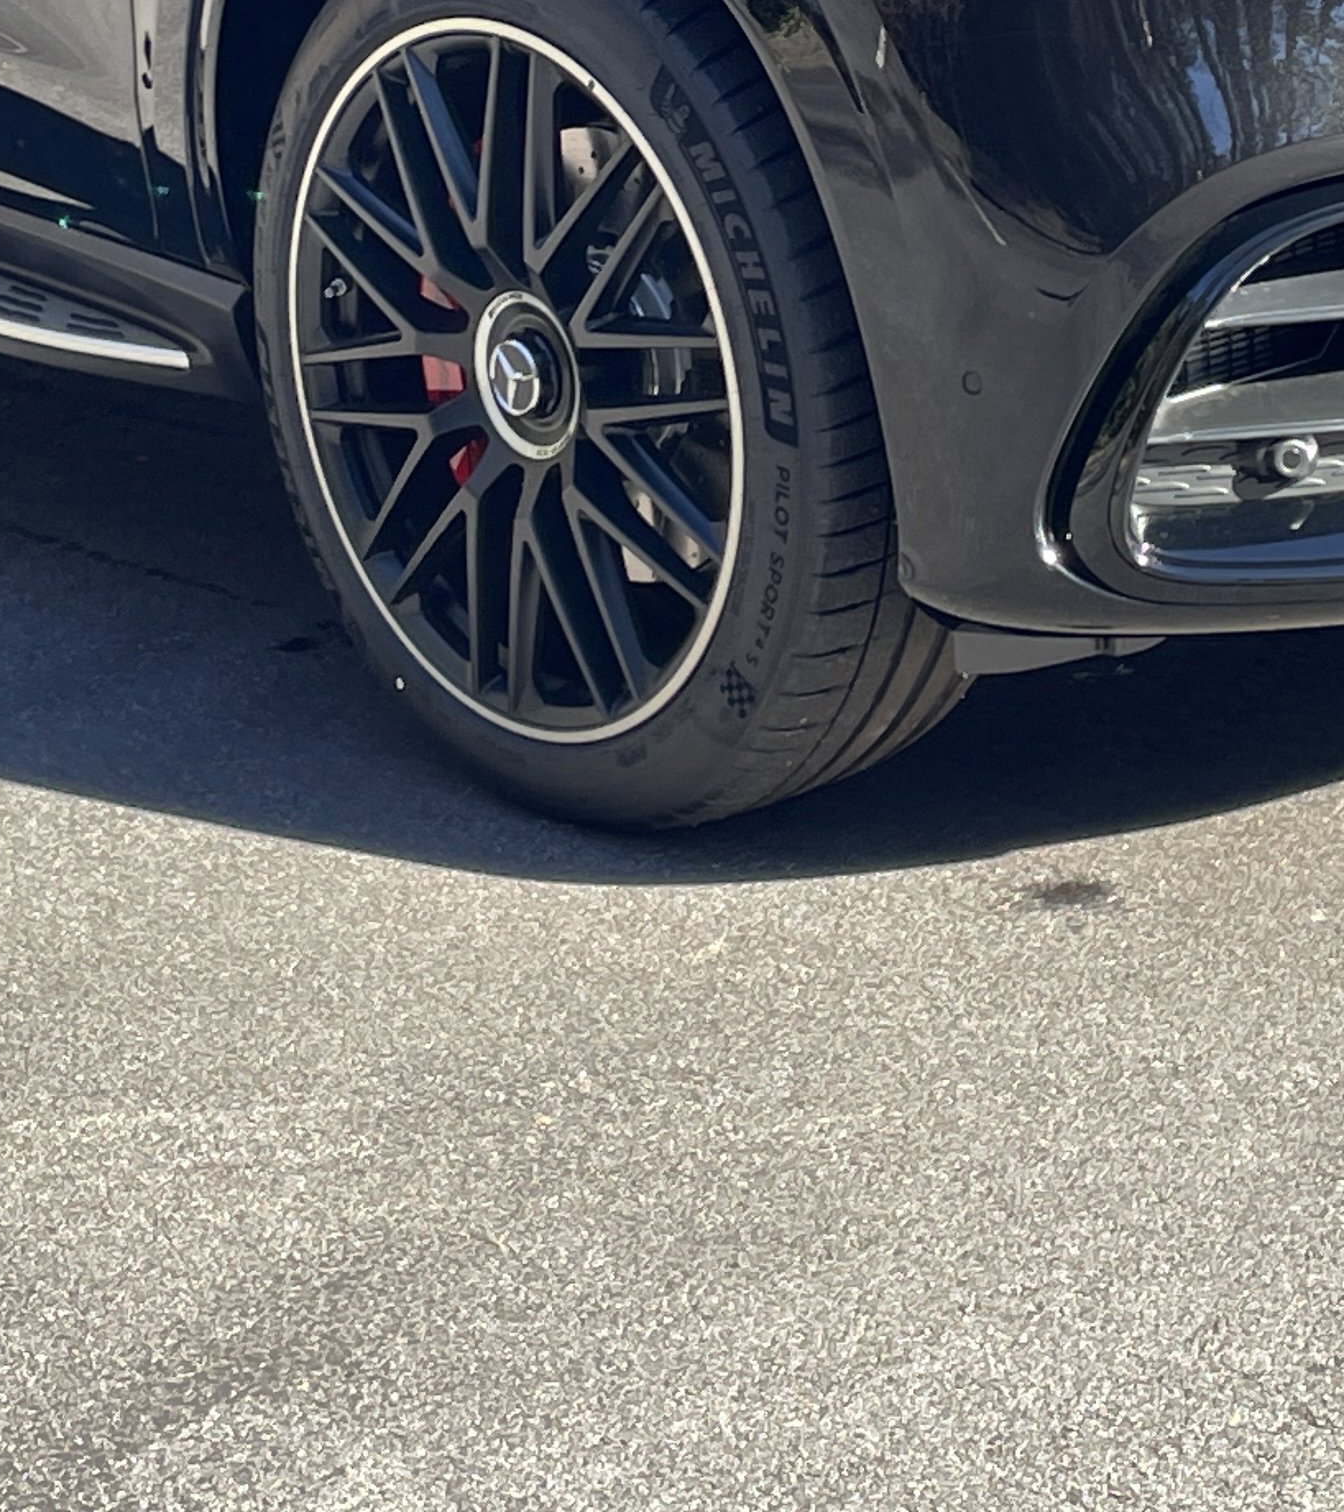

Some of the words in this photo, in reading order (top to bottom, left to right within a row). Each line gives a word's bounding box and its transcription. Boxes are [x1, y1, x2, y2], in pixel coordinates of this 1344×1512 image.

[690, 140, 795, 427] MICHELIN
[774, 464, 791, 545] PILOT
[757, 551, 784, 638] SPORT
